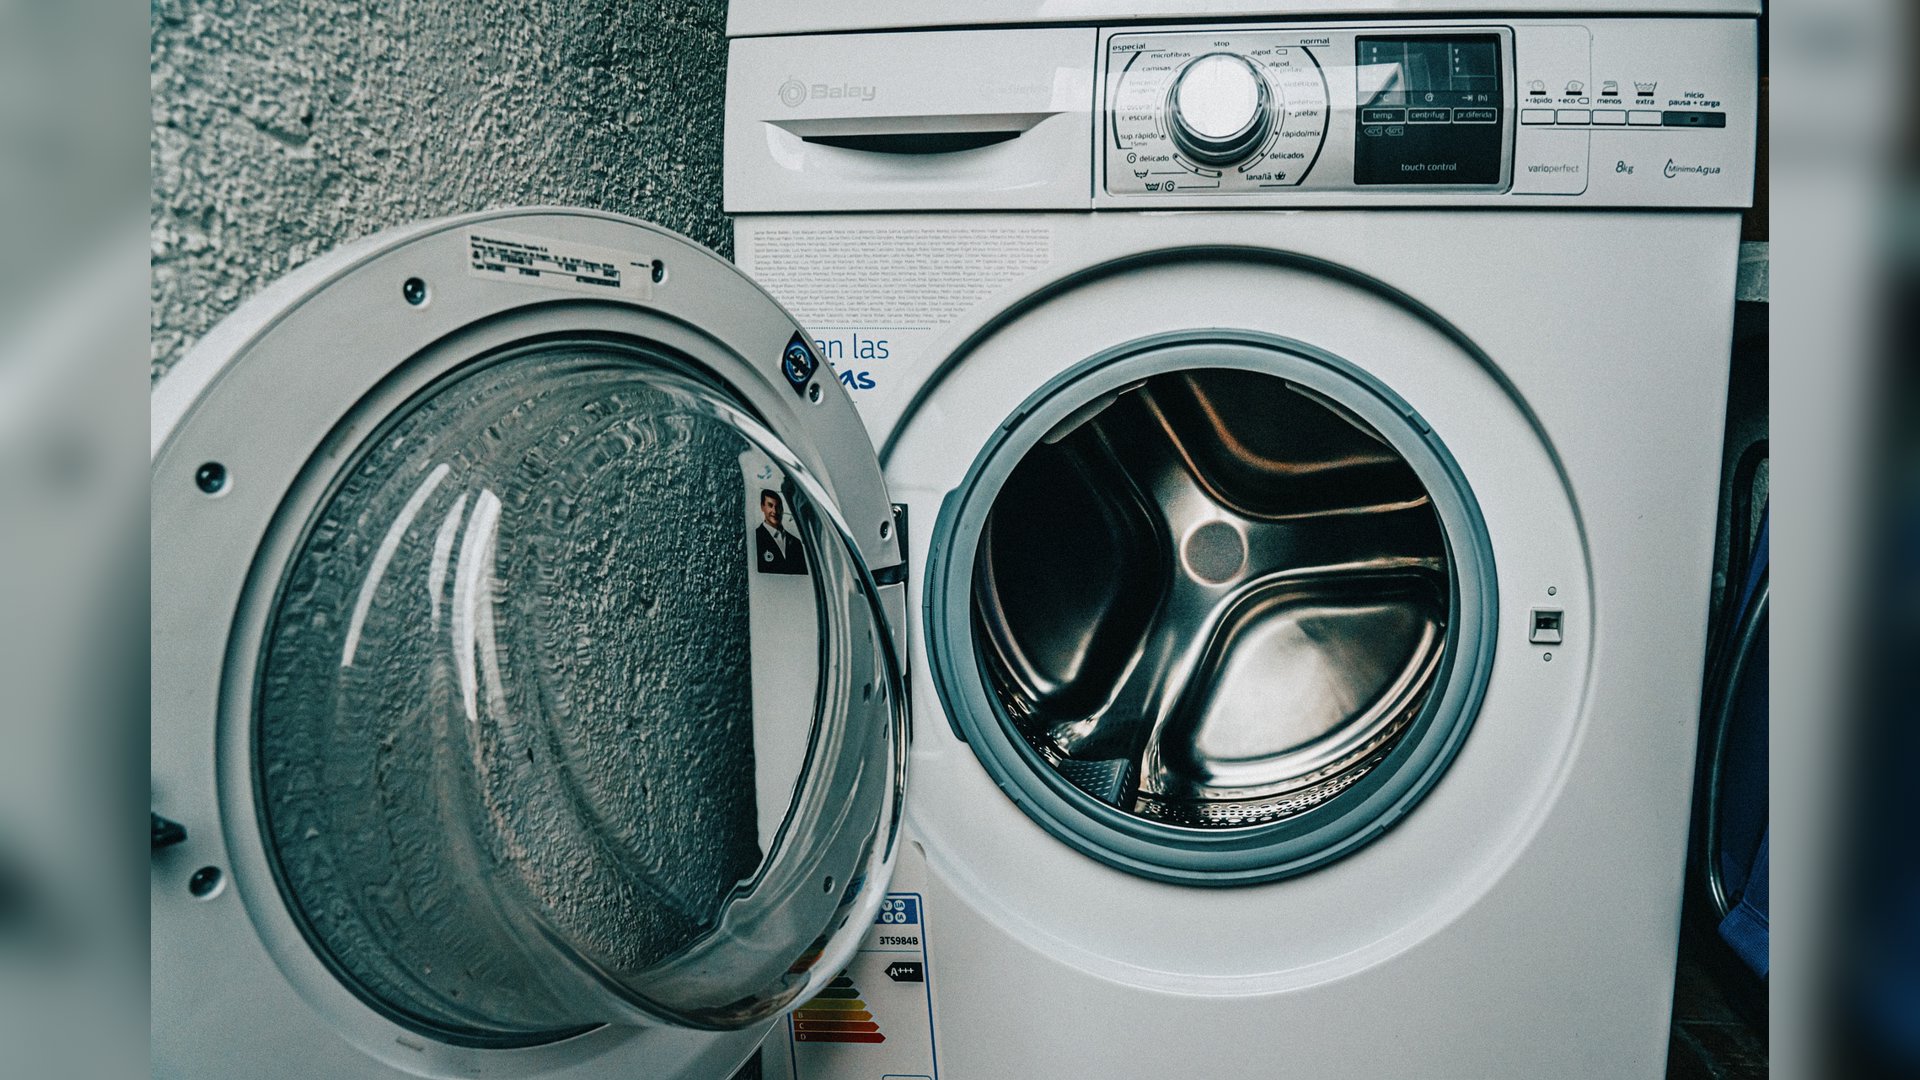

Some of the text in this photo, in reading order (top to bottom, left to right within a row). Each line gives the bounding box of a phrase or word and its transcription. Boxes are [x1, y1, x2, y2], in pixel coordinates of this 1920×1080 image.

[1213, 40, 1230, 48] stop
[1300, 37, 1330, 45] normal
[1112, 43, 1146, 51] especial
[1150, 51, 1191, 59] microfibras
[810, 81, 876, 102] Balay
[1684, 91, 1705, 99] inicio
[1699, 100, 1721, 108] carga
[1139, 154, 1170, 162] delicado
[1269, 152, 1305, 160] delicados
[1401, 163, 1457, 171] touch control
[1528, 165, 1579, 174] varioperfect
[1615, 160, 1635, 174] 8kg
[853, 333, 889, 359] las
[879, 936, 919, 945] 3TS984B
[890, 967, 914, 977] A+++
[800, 1033, 806, 1041] D
